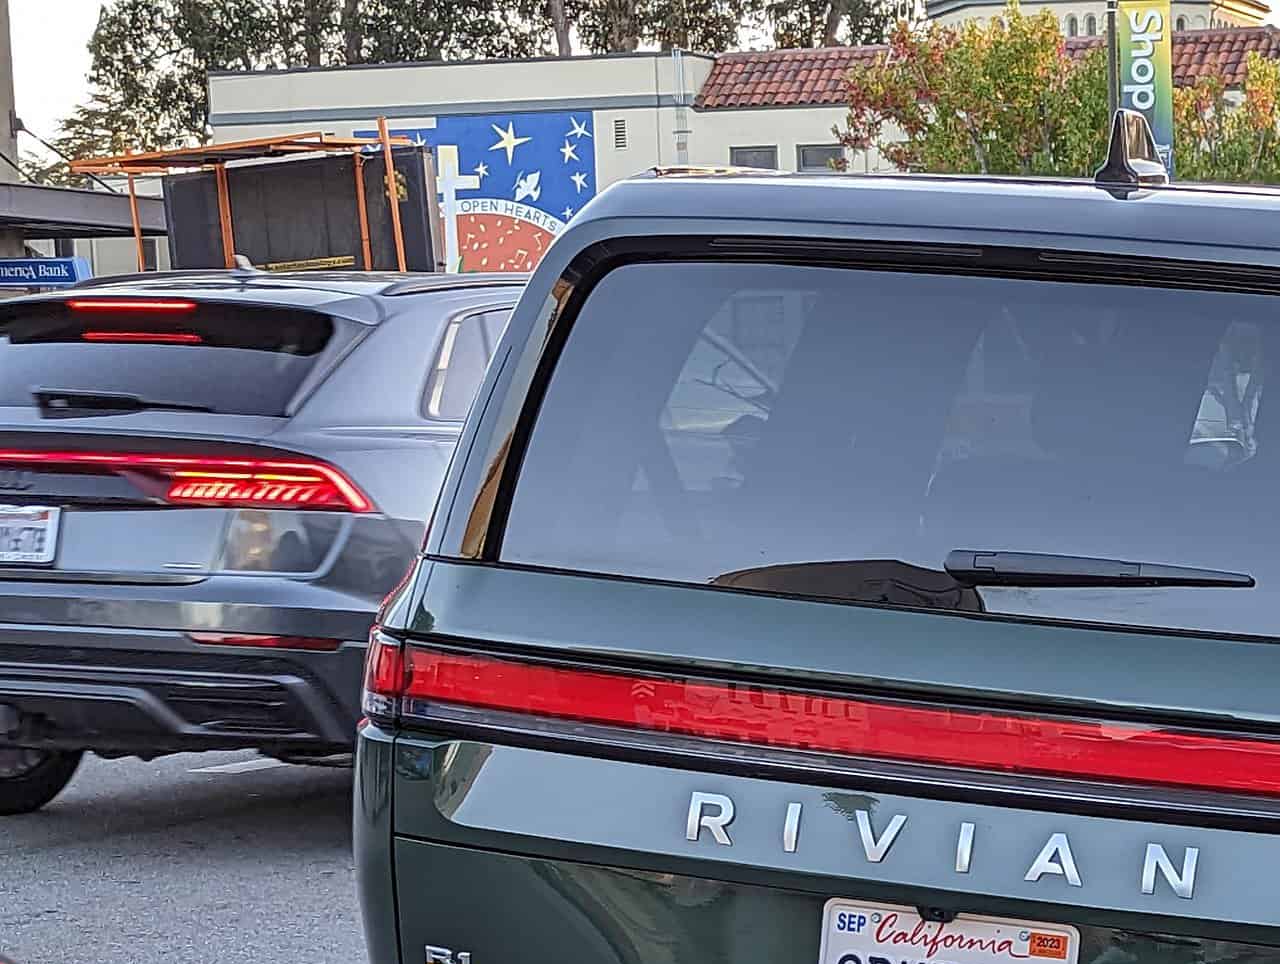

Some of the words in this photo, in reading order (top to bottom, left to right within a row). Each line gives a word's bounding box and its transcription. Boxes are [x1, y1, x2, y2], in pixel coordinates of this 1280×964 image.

[1123, 9, 1163, 110] Shop
[461, 200, 499, 212] OPEN
[504, 204, 557, 231] HEARTS
[39, 264, 69, 277] Bank
[686, 791, 1199, 899] RIVIAN
[837, 912, 866, 933] SEP
[873, 912, 1030, 959] California
[1037, 936, 1061, 949] 2023
